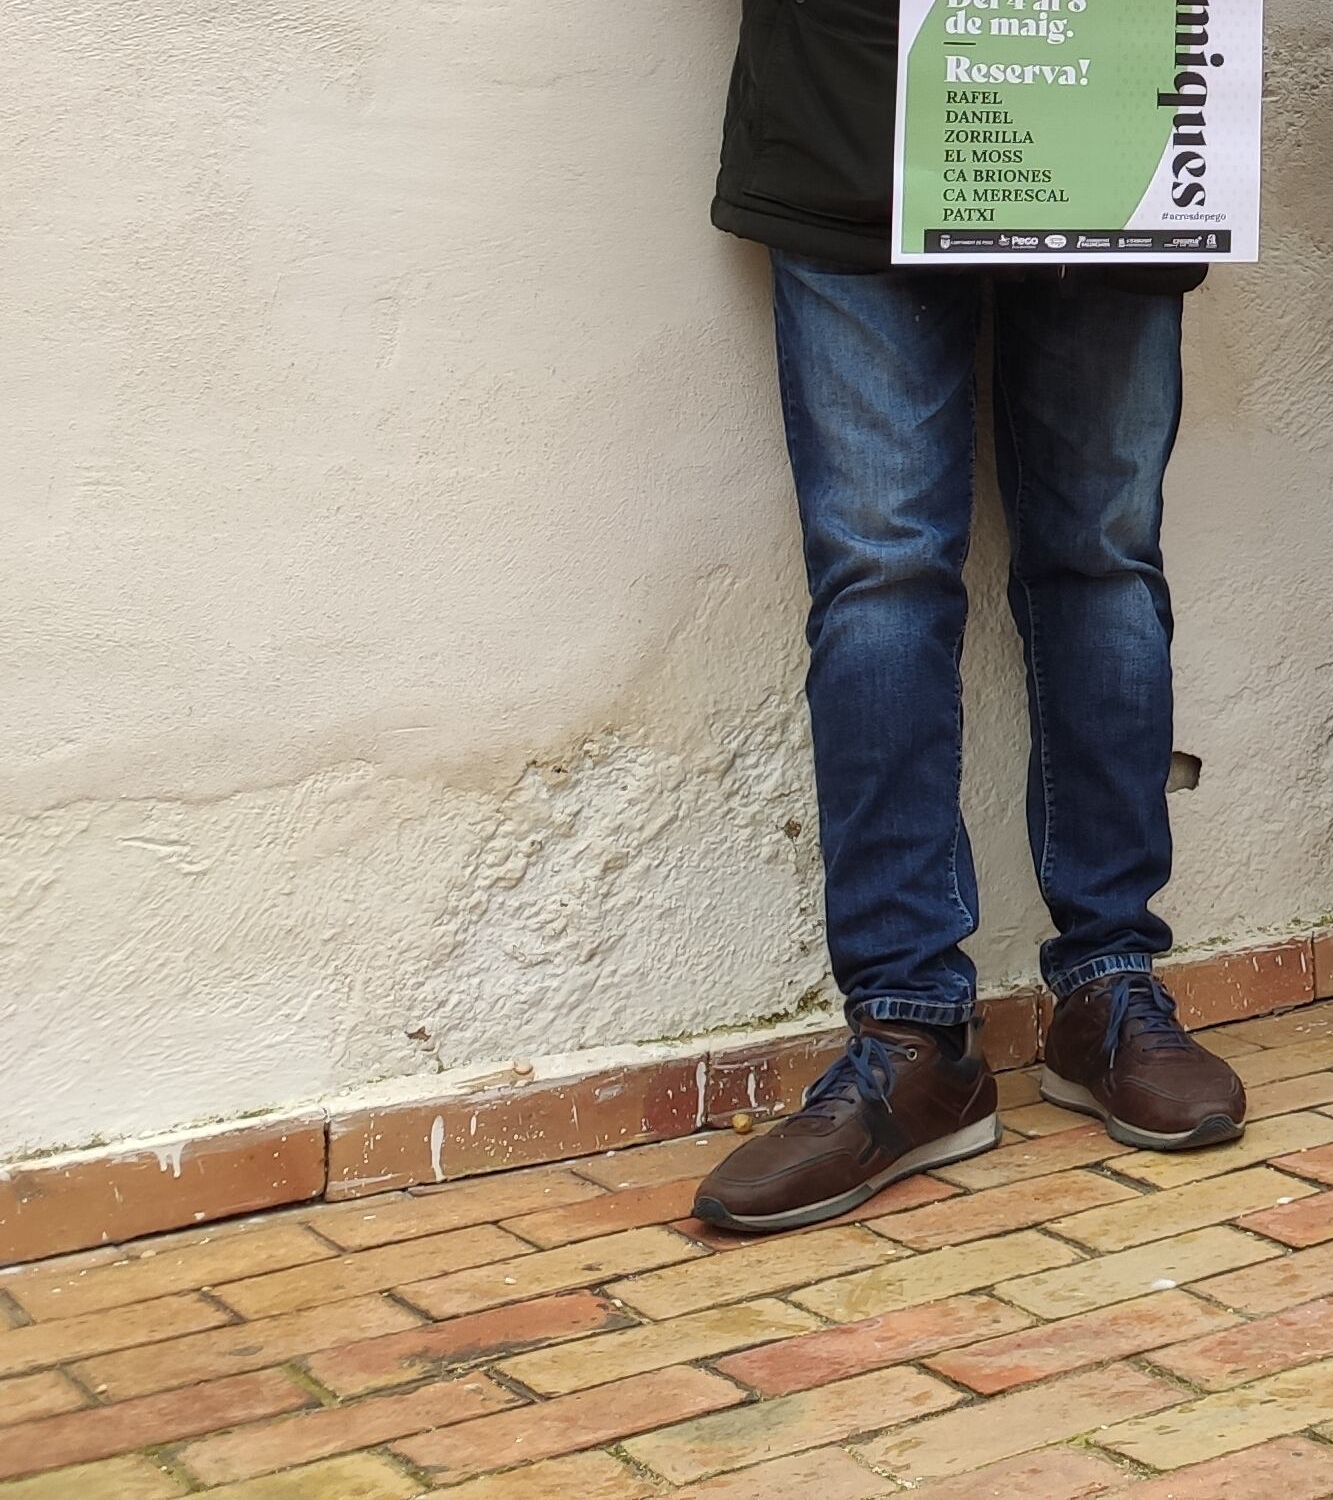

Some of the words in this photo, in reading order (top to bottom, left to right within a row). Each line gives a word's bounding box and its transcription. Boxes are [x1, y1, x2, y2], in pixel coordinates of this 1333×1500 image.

[945, 9, 982, 34] de
[990, 11, 1073, 44] maig.
[944, 55, 1090, 85] Reserva!
[946, 90, 1002, 104] RAFEL
[945, 110, 1013, 124] DANIEL
[944, 129, 1033, 143] ZORRILLA
[944, 149, 966, 162] EL
[972, 149, 1022, 163] MOSS
[943, 169, 967, 182] CA
[973, 169, 1051, 182] BRIONES
[943, 189, 966, 201] CA
[972, 188, 1069, 202] MERESCAL
[943, 208, 994, 221] PATXI
